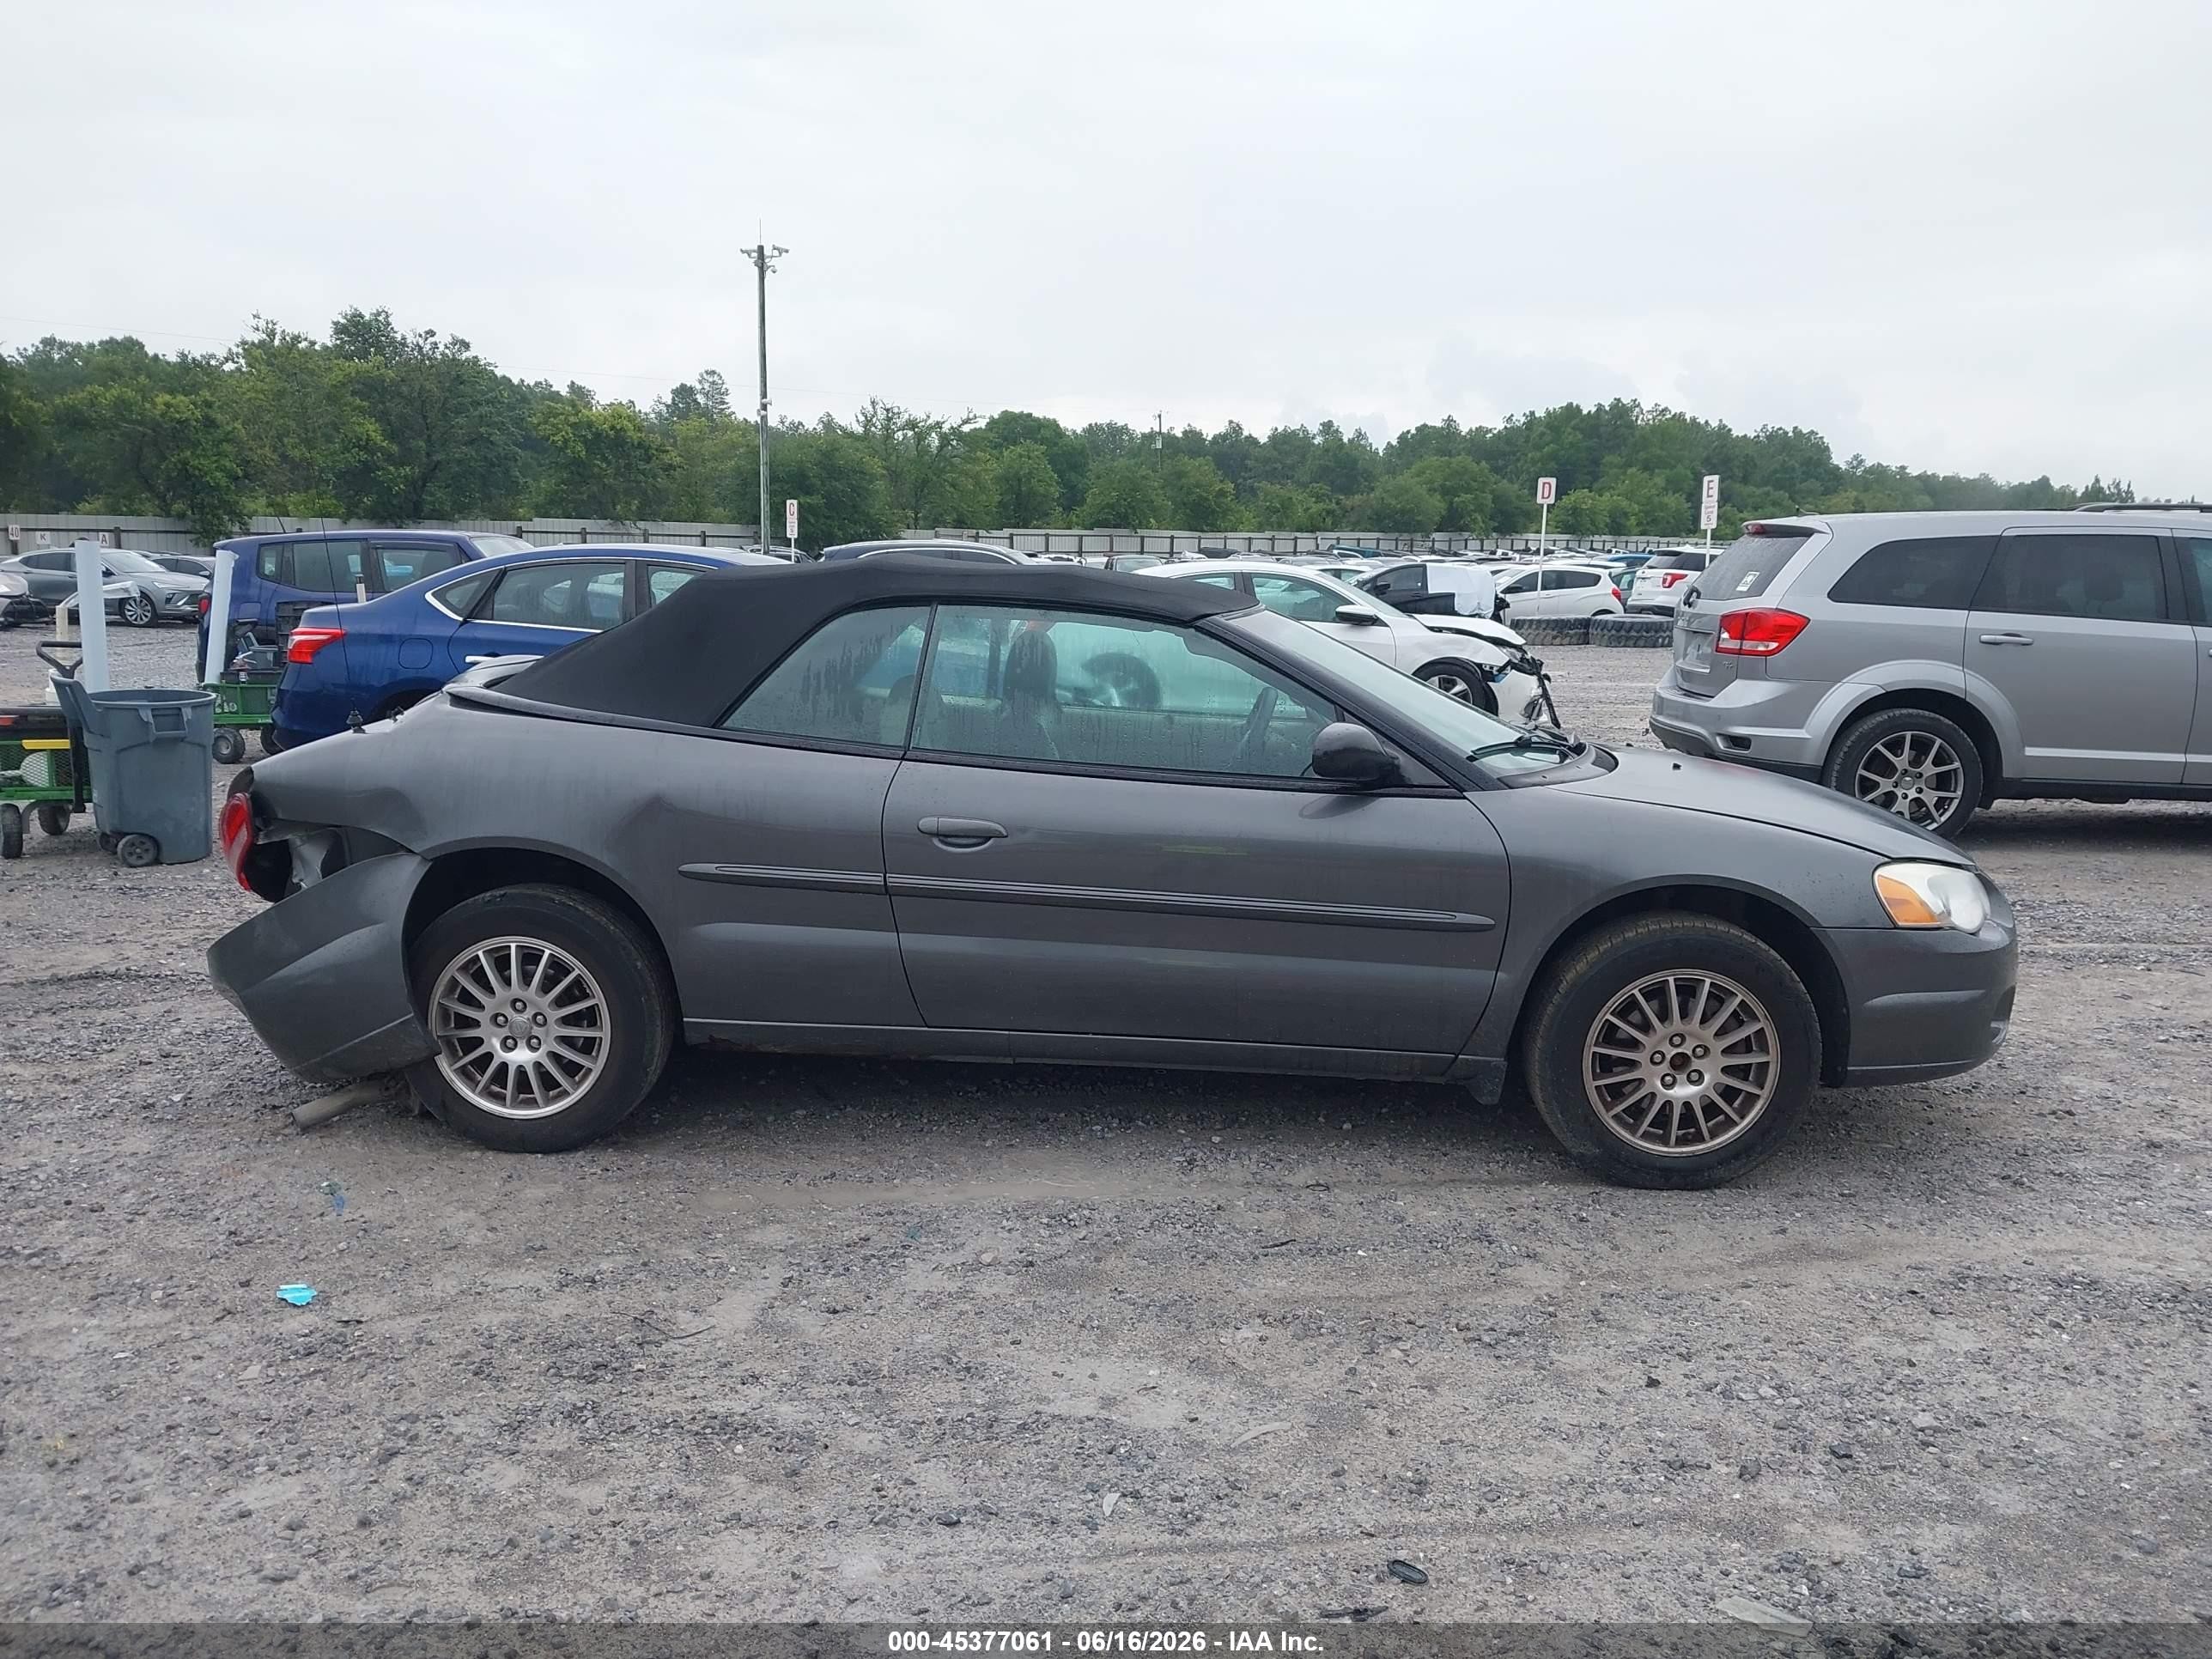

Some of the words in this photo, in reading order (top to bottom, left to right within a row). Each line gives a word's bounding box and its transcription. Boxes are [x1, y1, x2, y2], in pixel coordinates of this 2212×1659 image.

[1541, 482, 1552, 499] D
[1706, 480, 1714, 498] E
[788, 502, 795, 516] C
[101, 534, 108, 544] A
